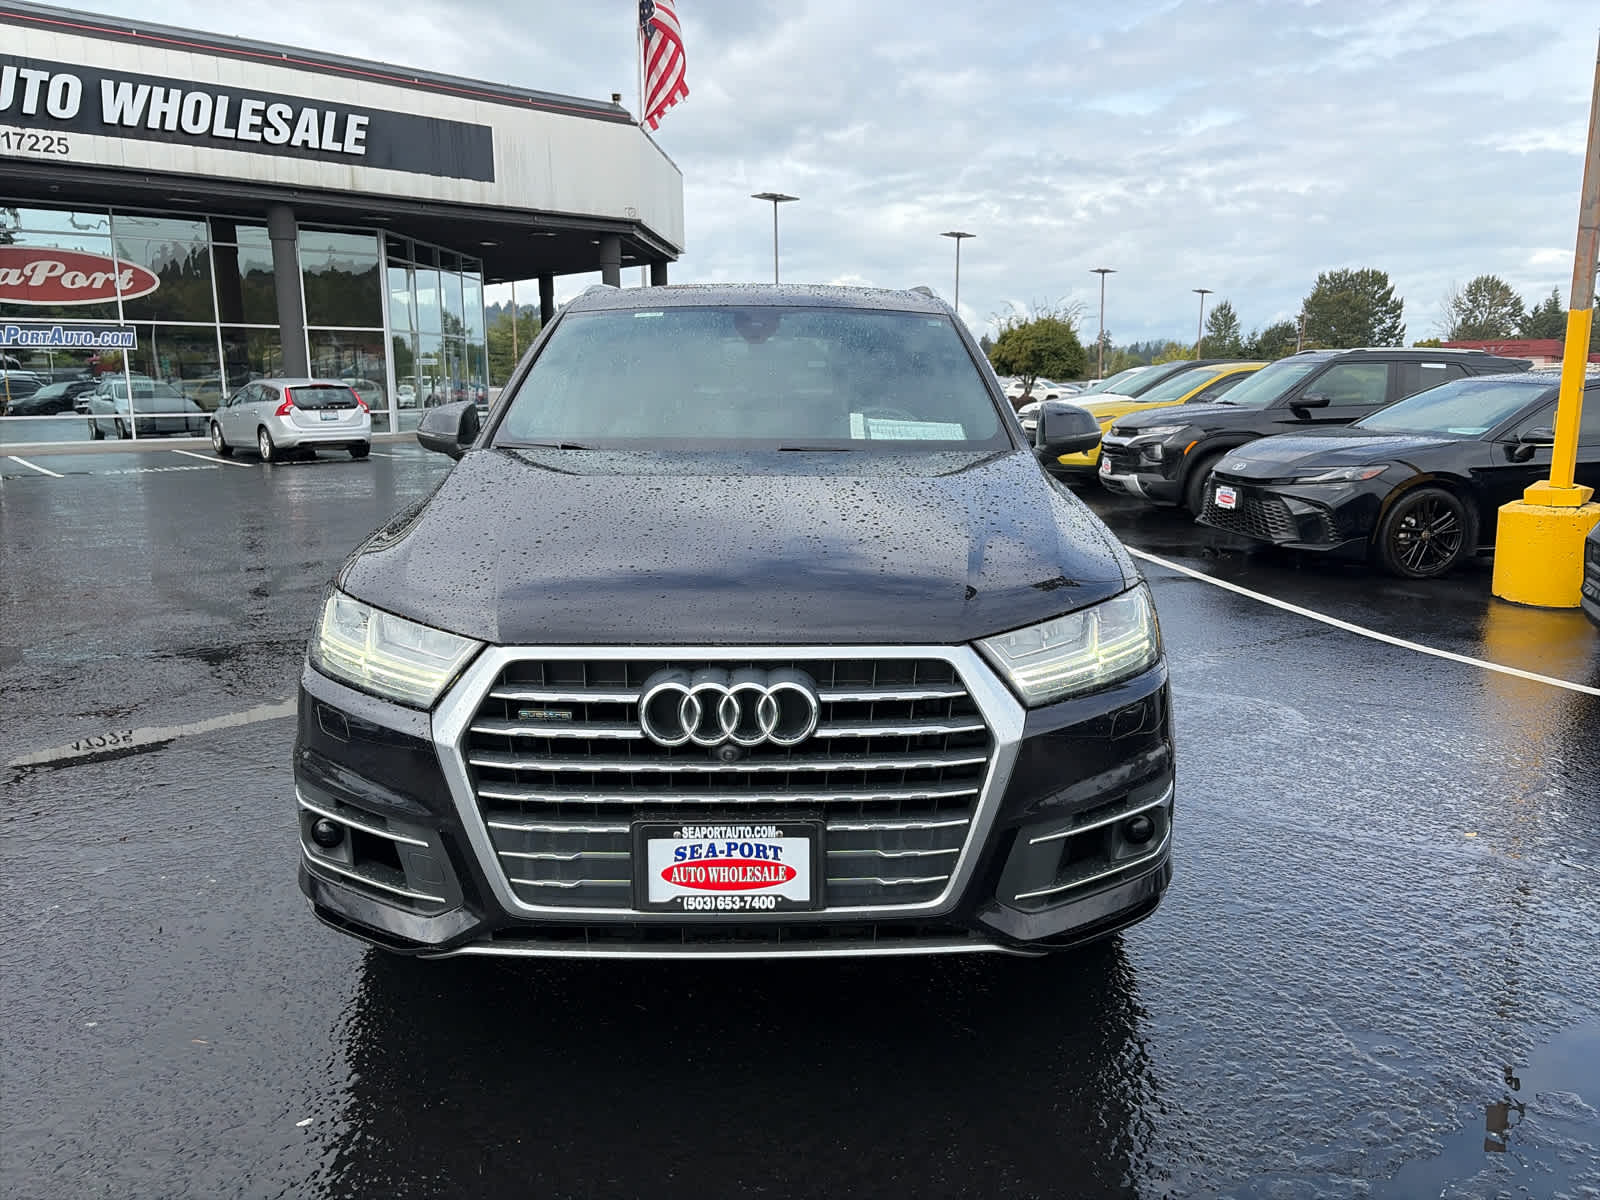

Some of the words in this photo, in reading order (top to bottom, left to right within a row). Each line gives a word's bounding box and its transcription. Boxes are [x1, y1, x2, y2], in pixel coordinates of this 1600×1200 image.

[100, 78, 370, 155] WHOLESALE
[1, 130, 70, 155] 17225
[681, 826, 776, 839] SEAPORTAUTO.COM
[673, 841, 783, 862] SEA-PORT
[671, 867, 706, 883] AUTO
[708, 866, 787, 883] WHOLESALE
